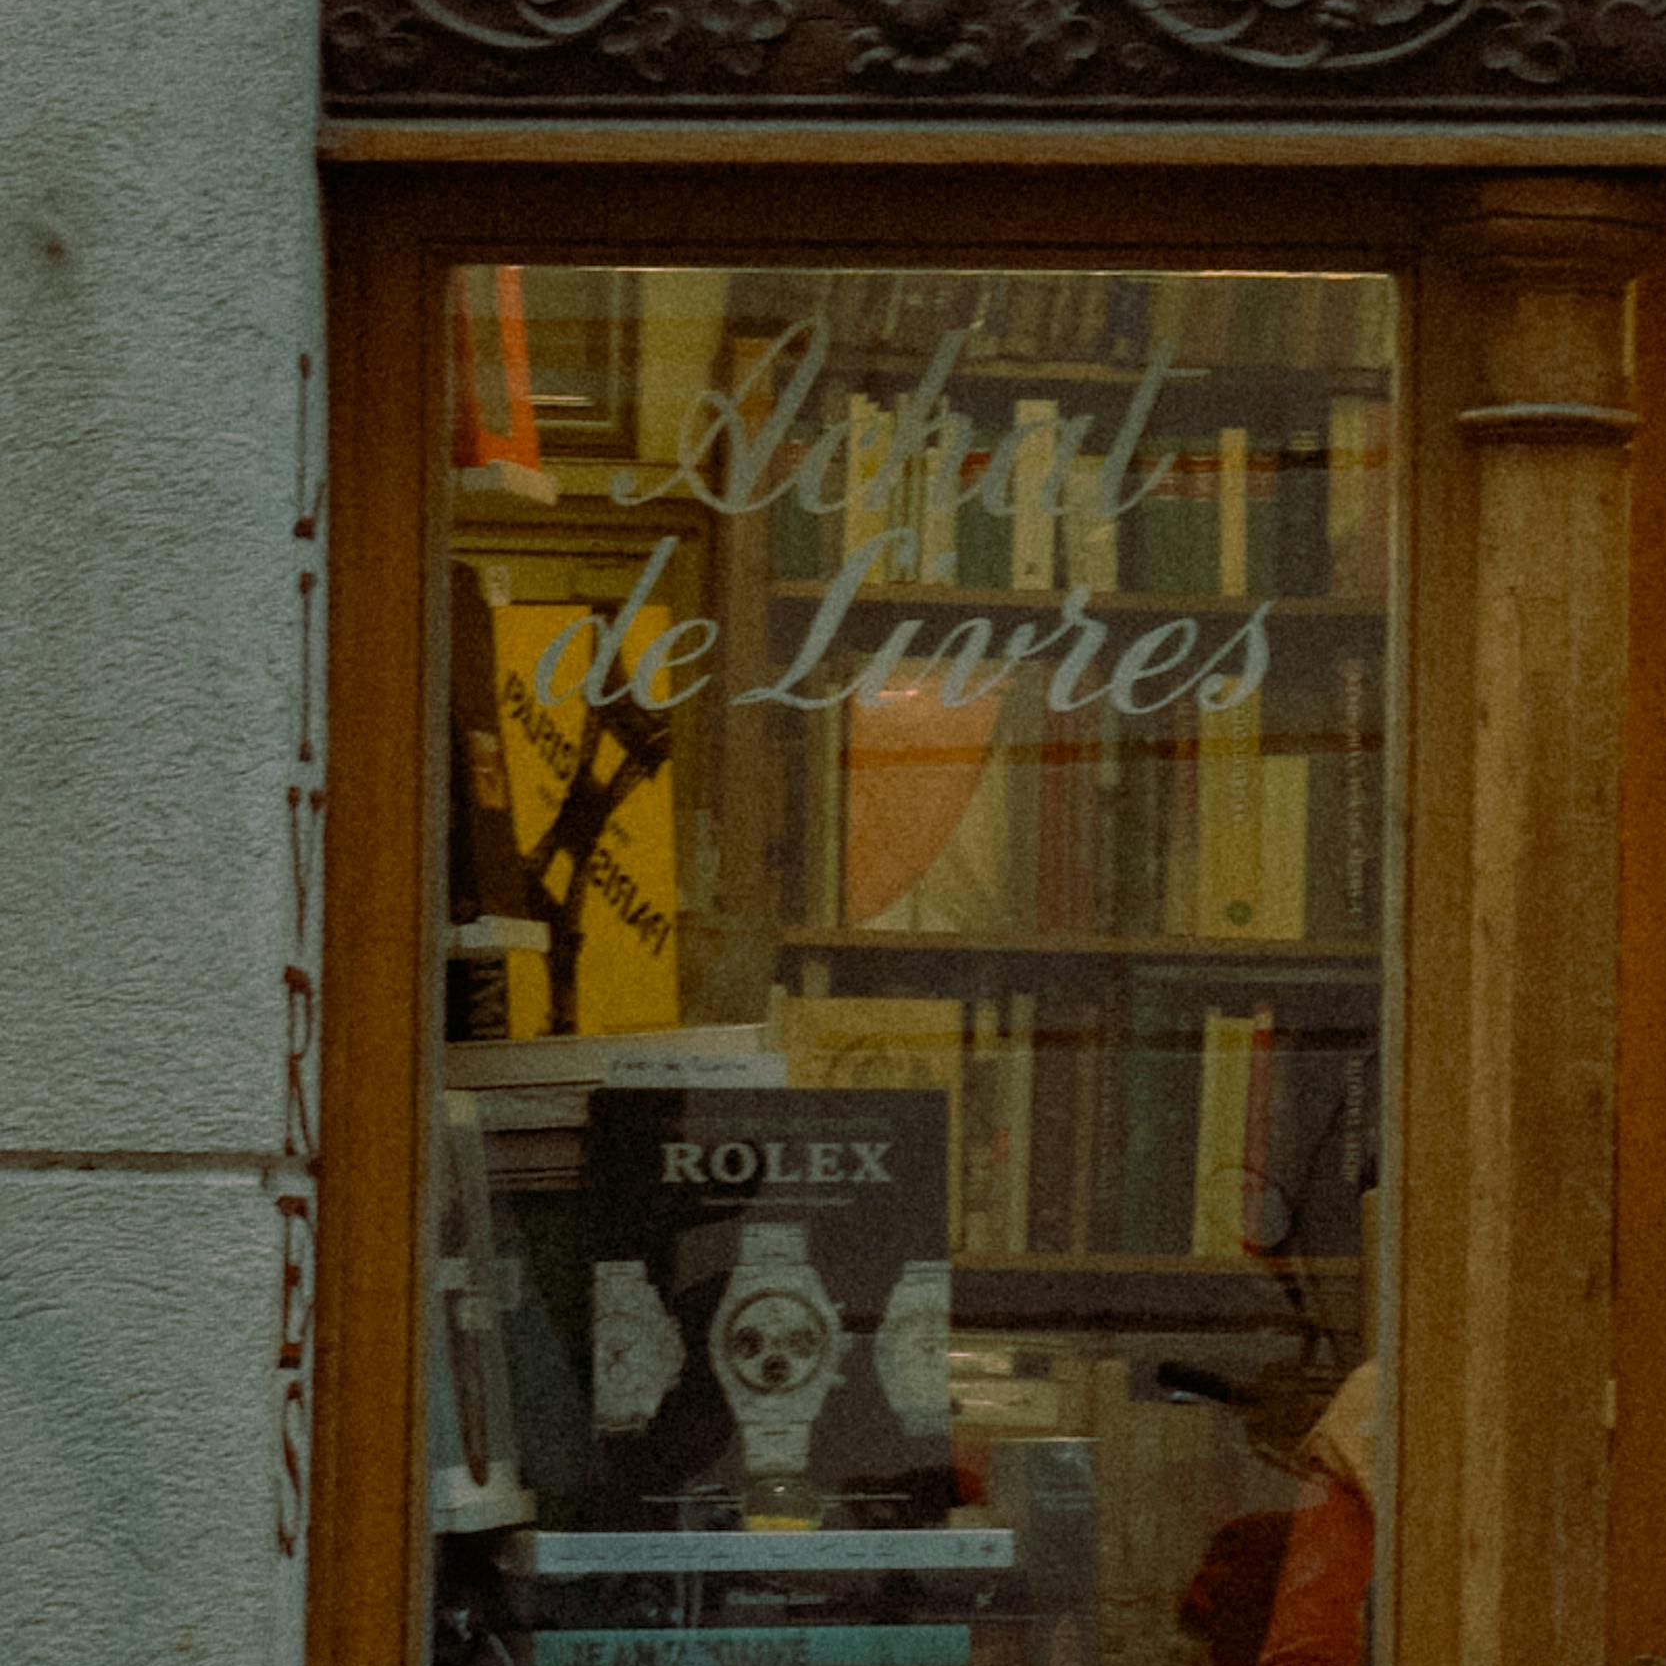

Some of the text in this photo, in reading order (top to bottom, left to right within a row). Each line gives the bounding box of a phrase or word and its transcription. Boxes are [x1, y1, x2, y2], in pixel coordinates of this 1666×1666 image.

[611, 308, 1211, 516] Achat
[533, 528, 1273, 715] de Livres
[660, 1141, 894, 1187] ROLEX
